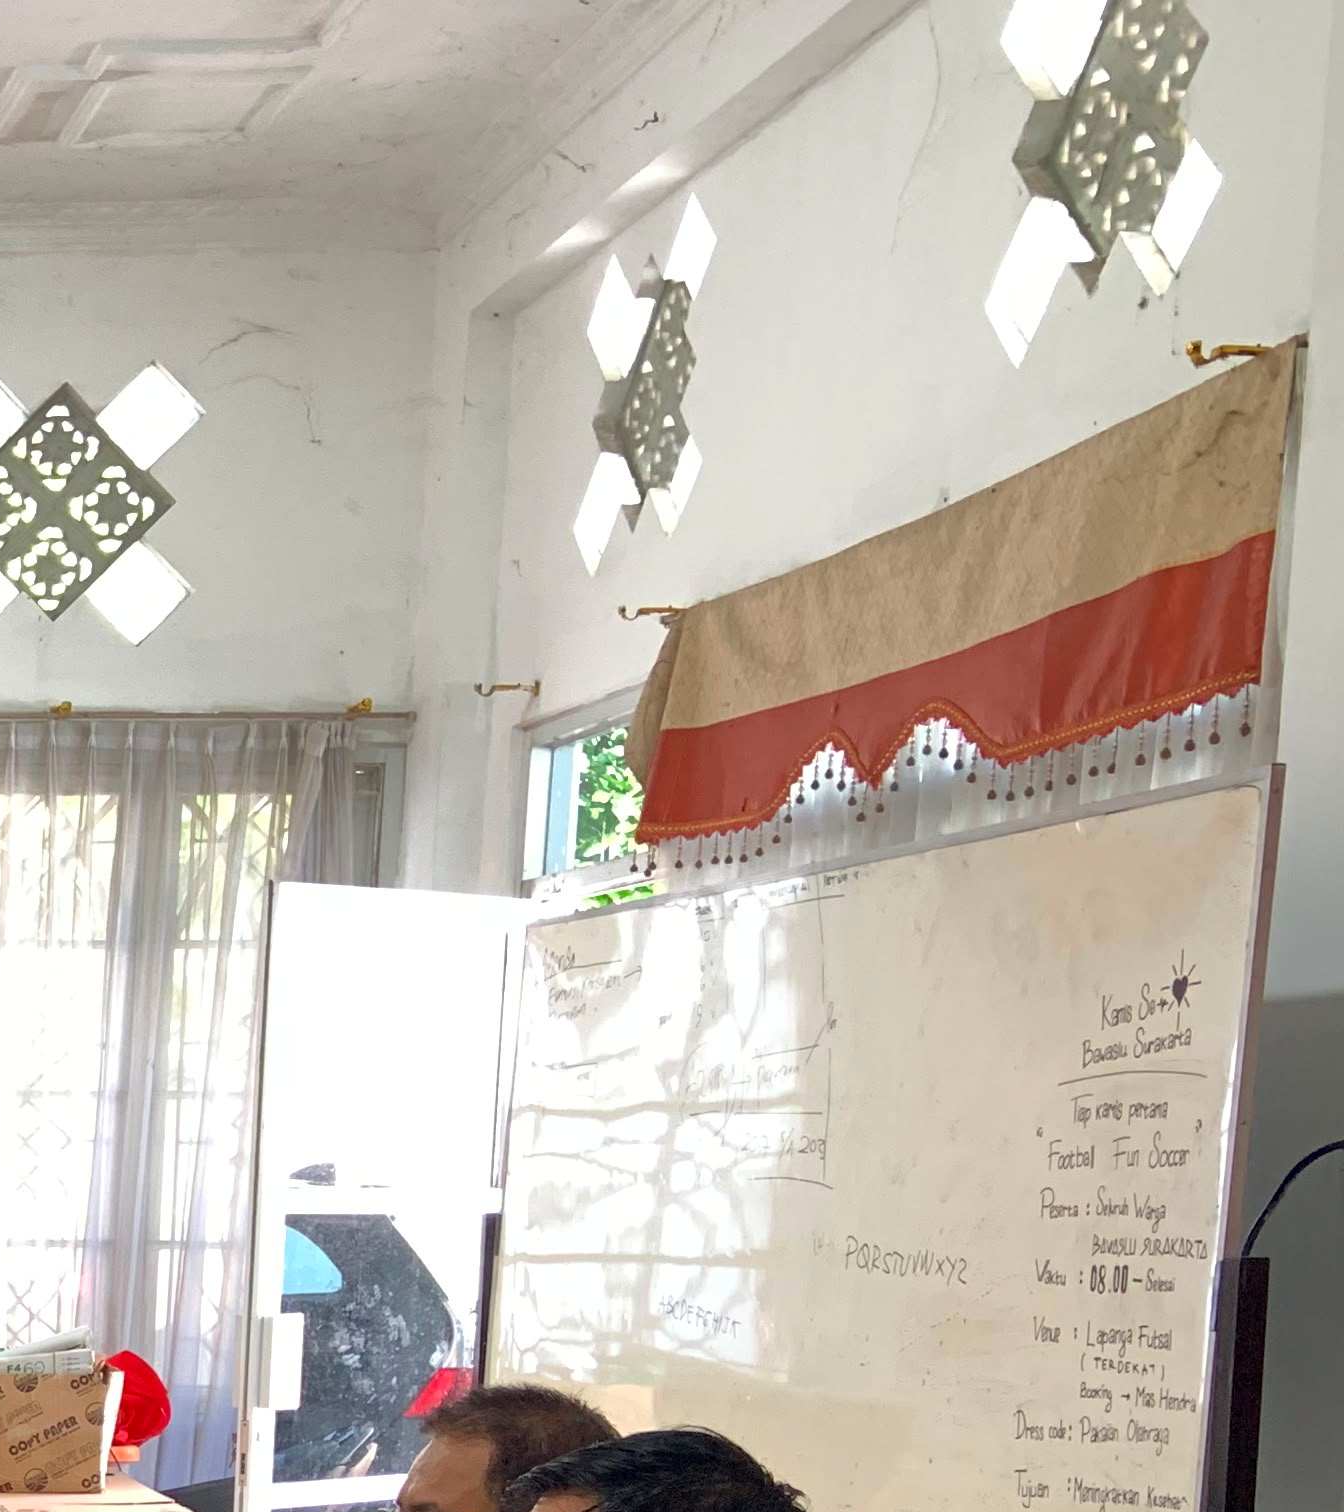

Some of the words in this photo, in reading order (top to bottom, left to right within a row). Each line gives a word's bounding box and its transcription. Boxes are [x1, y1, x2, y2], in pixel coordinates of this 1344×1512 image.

[1112, 1136, 1140, 1170] Fun
[1089, 1264, 1129, 1294] 08.00
[43, 1415, 79, 1441] PAPER
[1014, 1409, 1045, 1441] Dress
[1013, 1468, 1050, 1509] Tujuan
